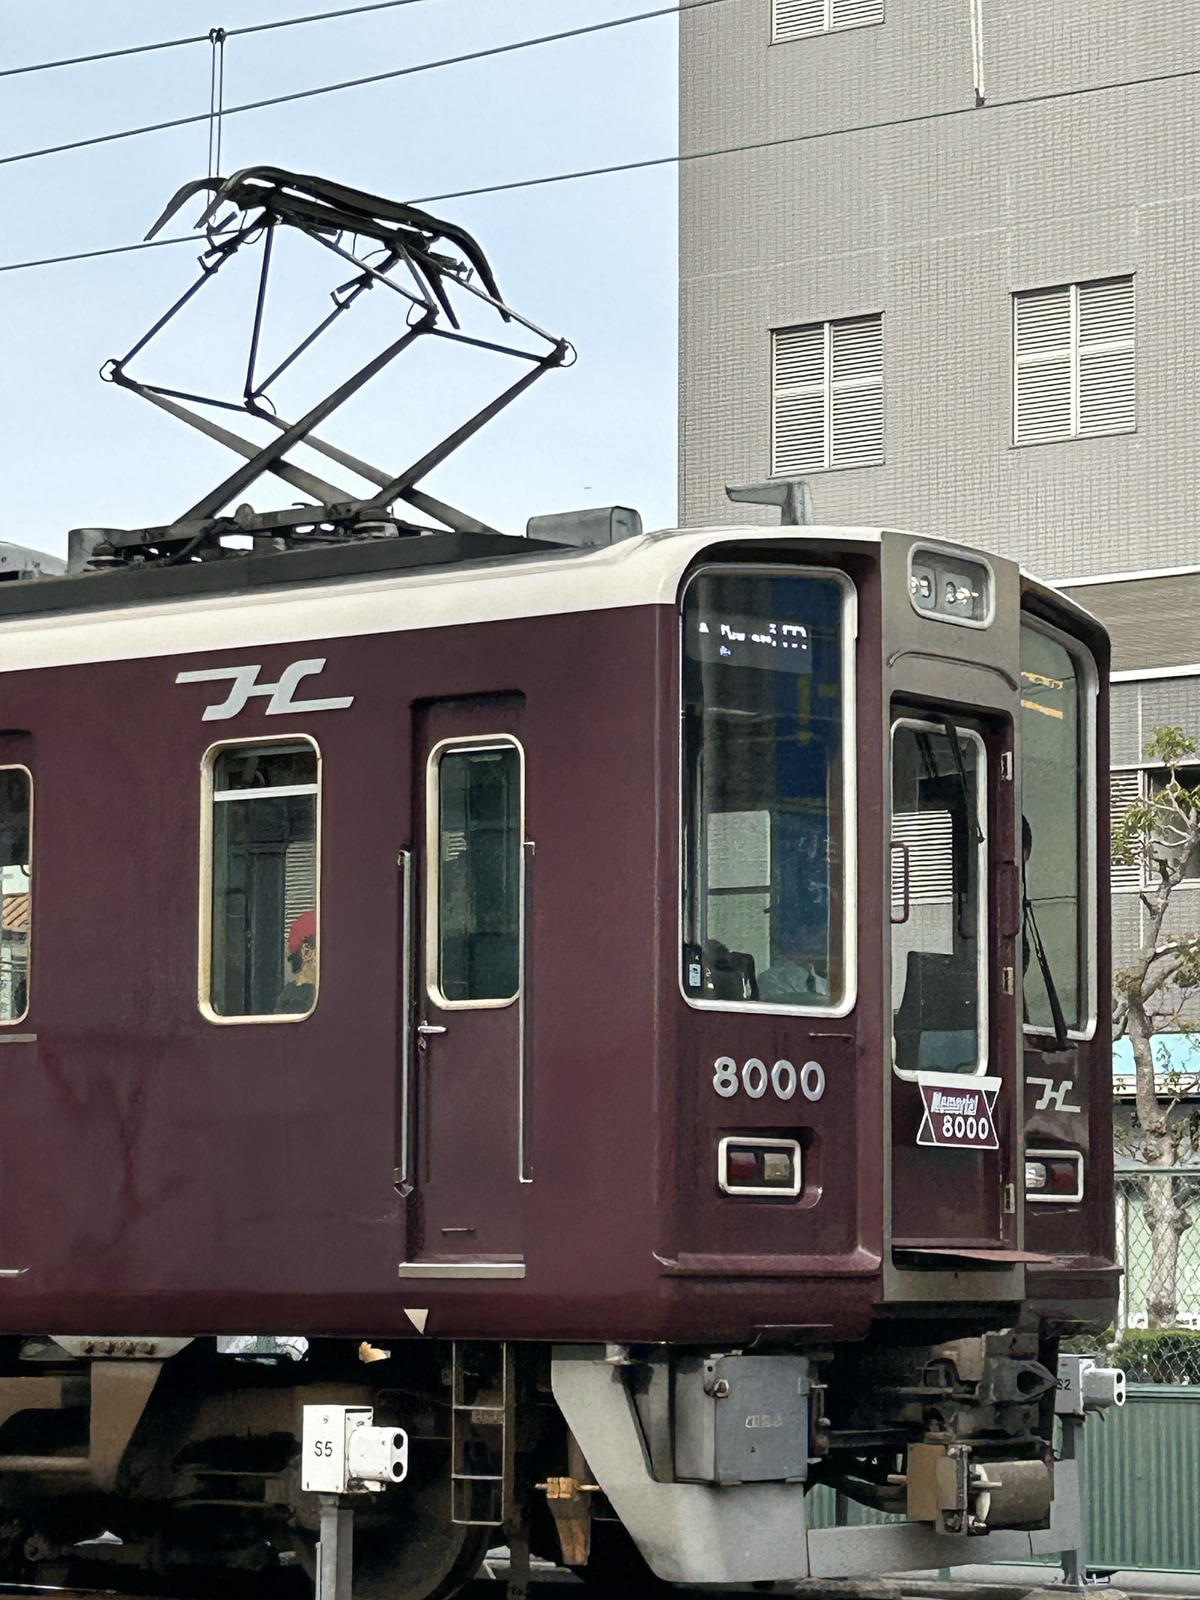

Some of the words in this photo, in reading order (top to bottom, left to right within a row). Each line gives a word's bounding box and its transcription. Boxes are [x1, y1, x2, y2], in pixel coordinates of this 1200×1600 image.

[712, 1056, 826, 1102] 8000
[942, 1115, 989, 1140] 8000
[313, 1440, 333, 1457] S5
